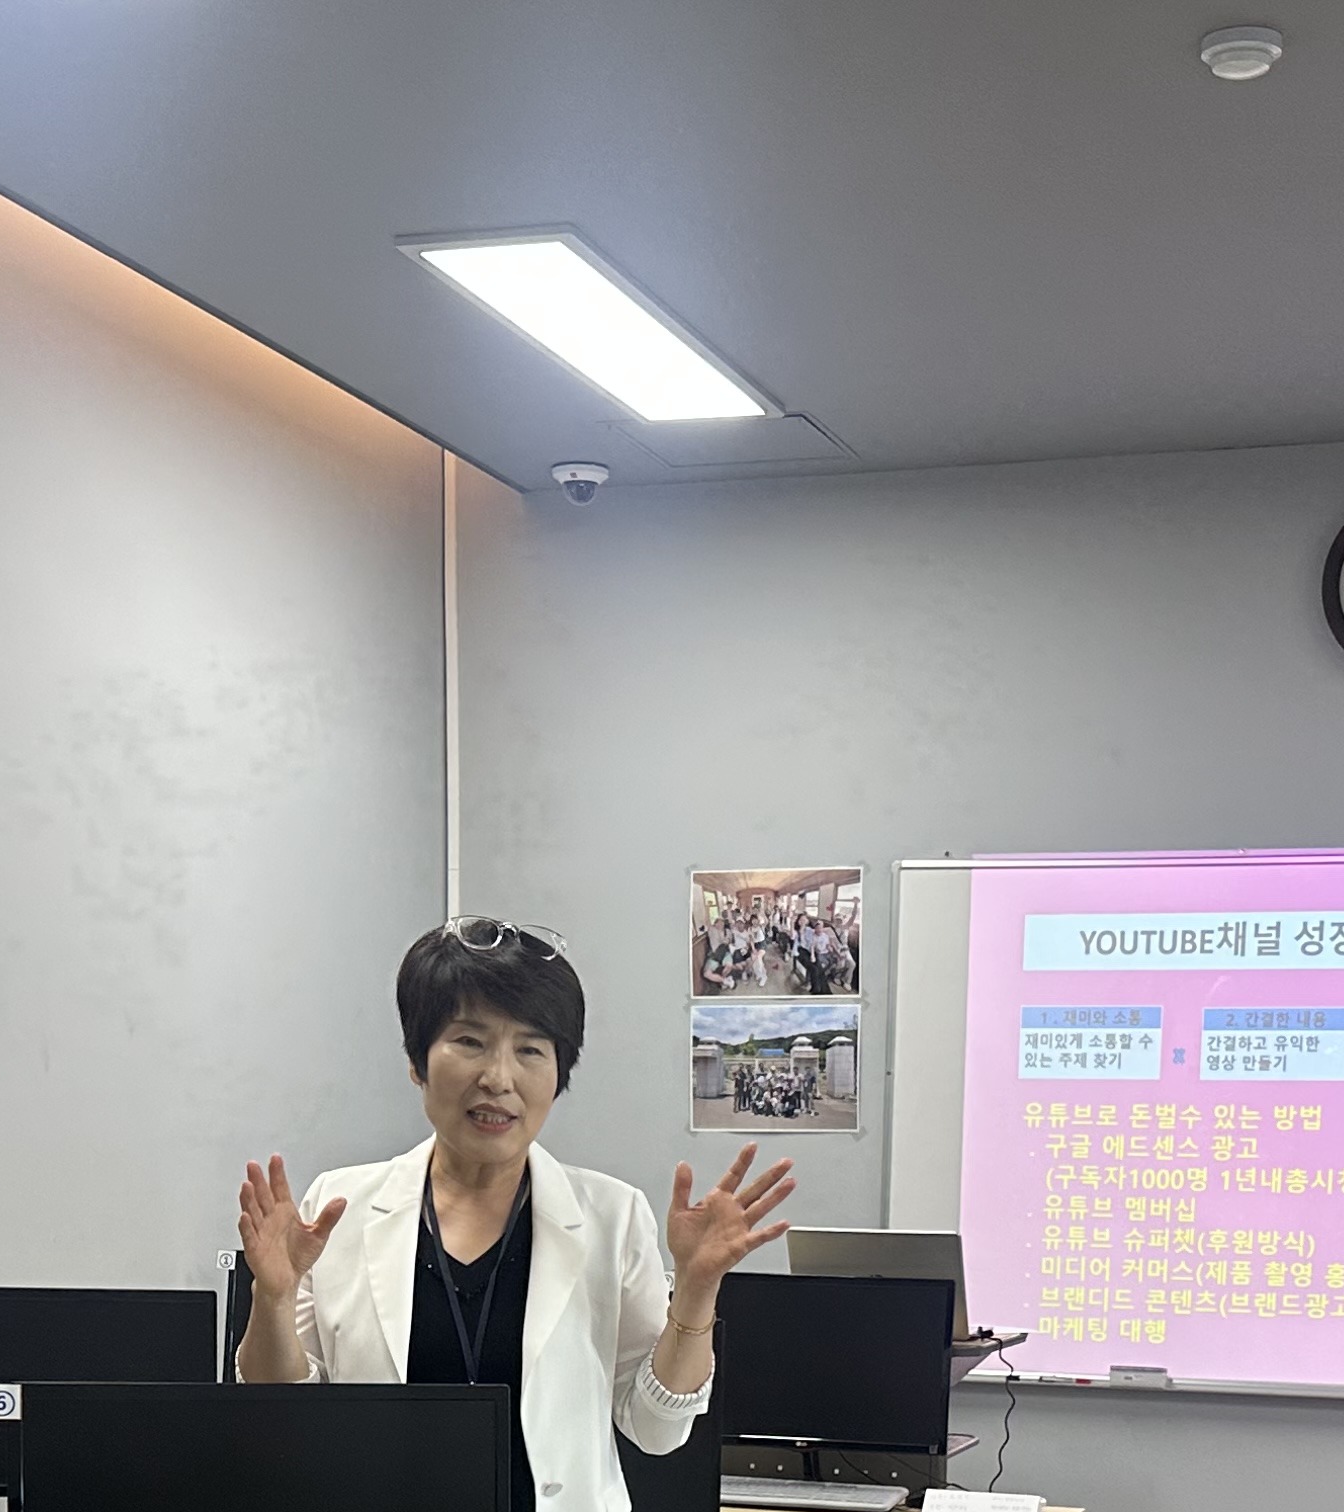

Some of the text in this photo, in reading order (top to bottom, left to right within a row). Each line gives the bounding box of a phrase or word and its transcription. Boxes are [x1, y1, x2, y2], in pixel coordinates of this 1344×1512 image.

[1079, 921, 1281, 957] YOUTUBE채널
[1063, 1009, 1107, 1026] 재미와
[1112, 1009, 1142, 1026] 소통
[1225, 1010, 1326, 1028] 2. 간결한 내용
[1024, 1033, 1153, 1050] 재미있게 소통할 수
[1207, 1035, 1320, 1053] 간결하고 유익한
[1024, 1052, 1122, 1070] 있는 주제 찾기
[1206, 1055, 1287, 1073] 영상 만들기
[1022, 1102, 1322, 1131] 유튜브로 돈벌수 있는 방법
[1045, 1133, 1261, 1162] 구글 에드센스 광고
[1045, 1165, 1208, 1192] (구독자1000명
[1043, 1194, 1197, 1223] 유튜브 멤버십
[1041, 1225, 1113, 1251] 유튜브
[1040, 1255, 1111, 1282] 미디어
[1121, 1257, 1254, 1287] 커머스(제품
[1264, 1261, 1314, 1288] 촬영
[1039, 1286, 1135, 1314] 브랜디드
[1038, 1316, 1169, 1345] 마케팅 대행
